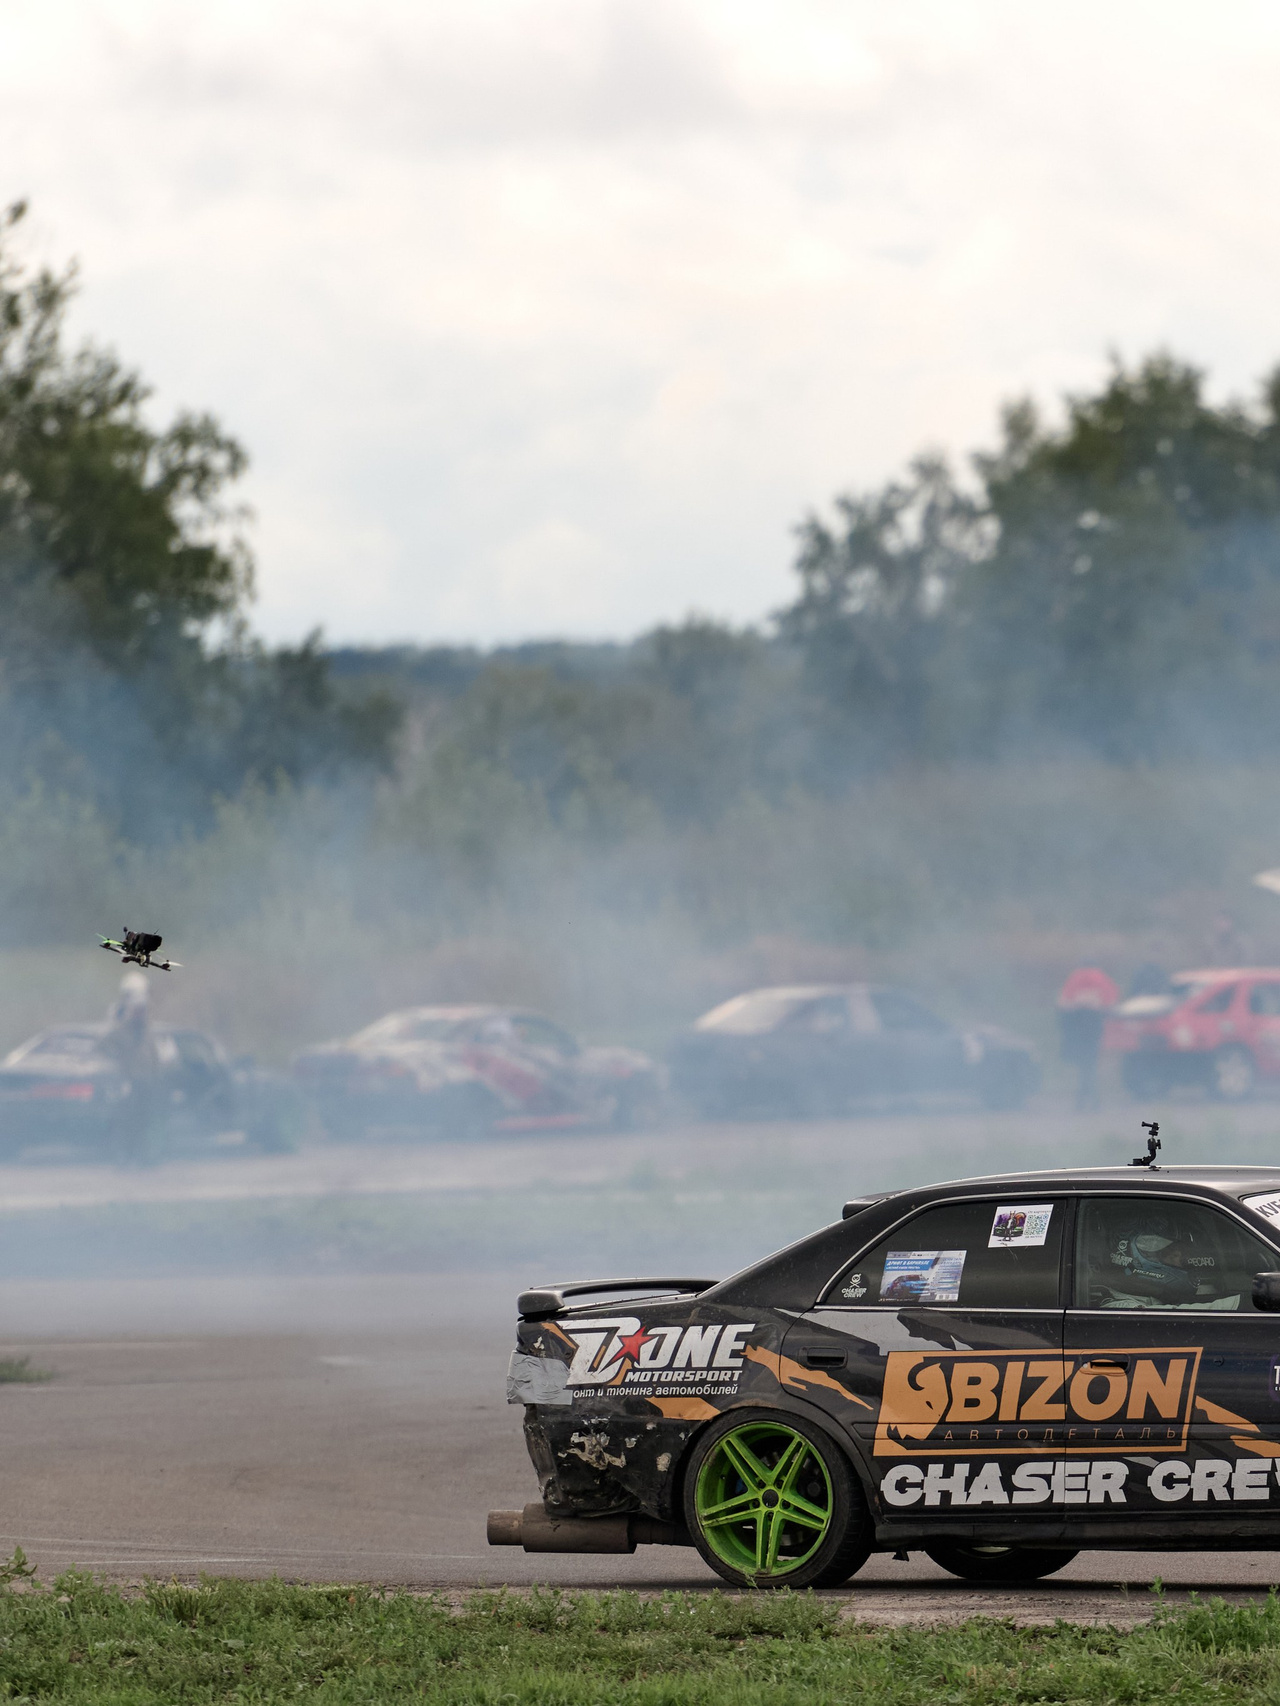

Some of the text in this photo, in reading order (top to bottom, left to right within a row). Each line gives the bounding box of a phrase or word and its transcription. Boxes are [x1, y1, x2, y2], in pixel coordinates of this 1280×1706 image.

[573, 1383, 738, 1399] онт и тюнинг автомобилей
[624, 1370, 743, 1383] MOTORSPORT
[945, 1358, 1188, 1422] BIZON
[880, 1461, 1130, 1507] CHASER
